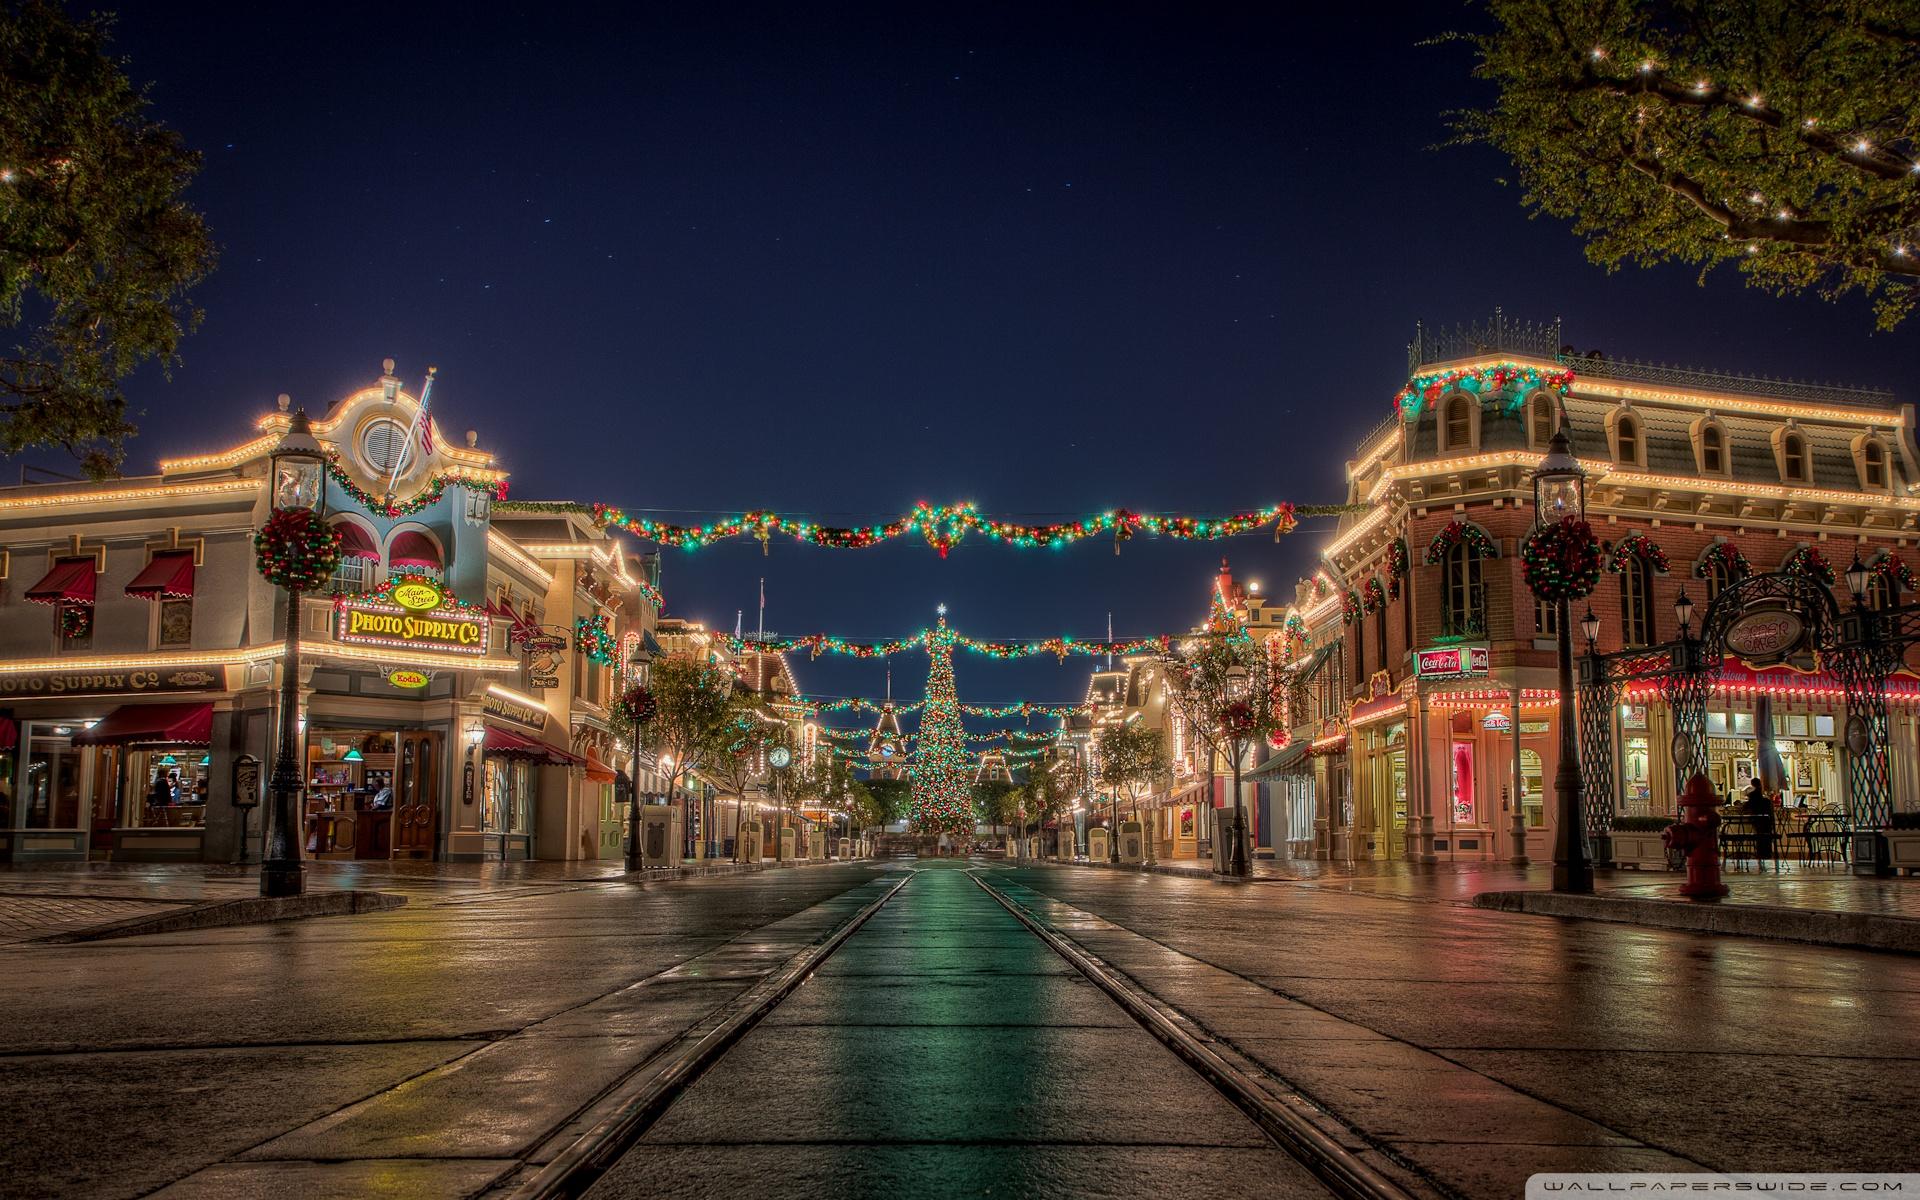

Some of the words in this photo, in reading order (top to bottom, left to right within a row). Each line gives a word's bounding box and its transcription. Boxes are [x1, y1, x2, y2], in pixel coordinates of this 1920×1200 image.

[399, 587, 430, 598] Main
[408, 595, 435, 607] Street
[350, 610, 403, 634] PHOTO
[403, 616, 460, 640] SUPPLY
[1422, 655, 1457, 670] Coca-Cola
[397, 675, 421, 683] Kodak
[1708, 666, 1747, 682] licious
[0, 678, 44, 692] OTO
[49, 674, 125, 692] SUPPLY
